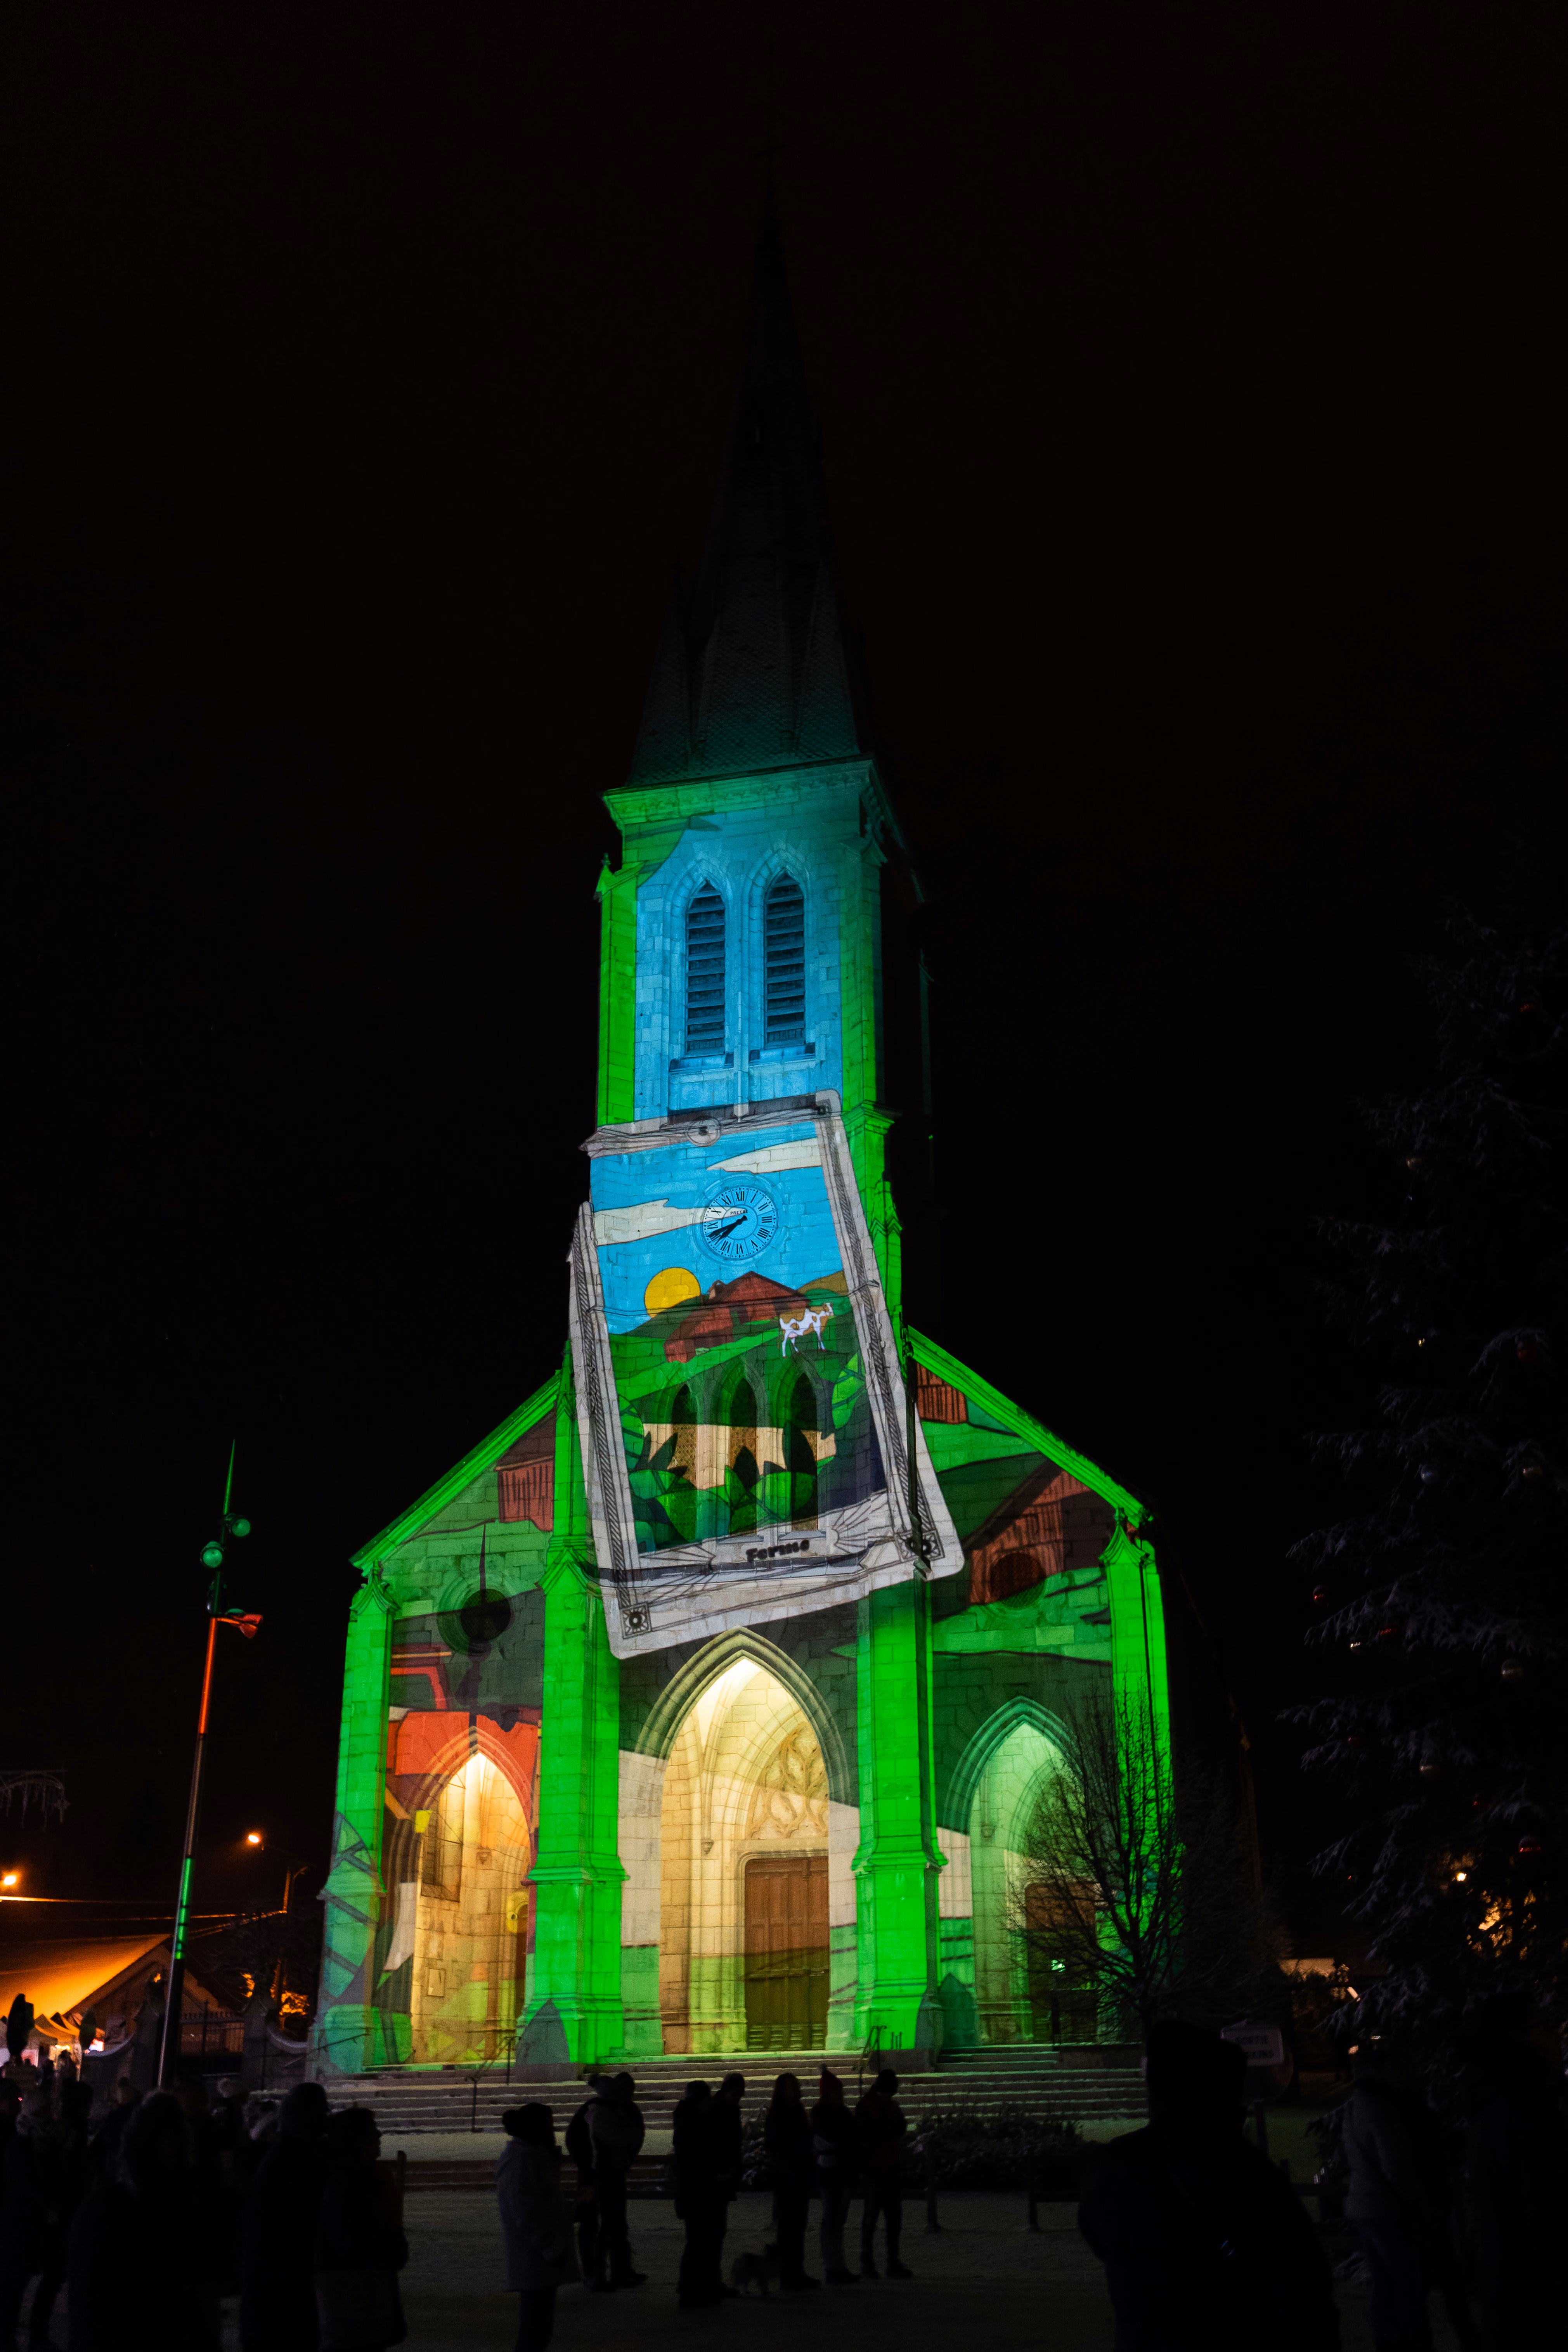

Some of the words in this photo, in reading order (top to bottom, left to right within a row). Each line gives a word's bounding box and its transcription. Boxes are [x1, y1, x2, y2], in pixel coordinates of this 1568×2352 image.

[721, 1195, 732, 1207] XI
[736, 1191, 745, 1202] XII
[750, 1193, 757, 1203] I
[711, 1207, 721, 1216] X
[758, 1202, 769, 1211] II
[757, 1228, 770, 1239] IIII
[720, 1240, 731, 1253] VII
[736, 1244, 743, 1254] VI
[750, 1239, 758, 1249] V
[1248, 2050, 1274, 2059] RKING
